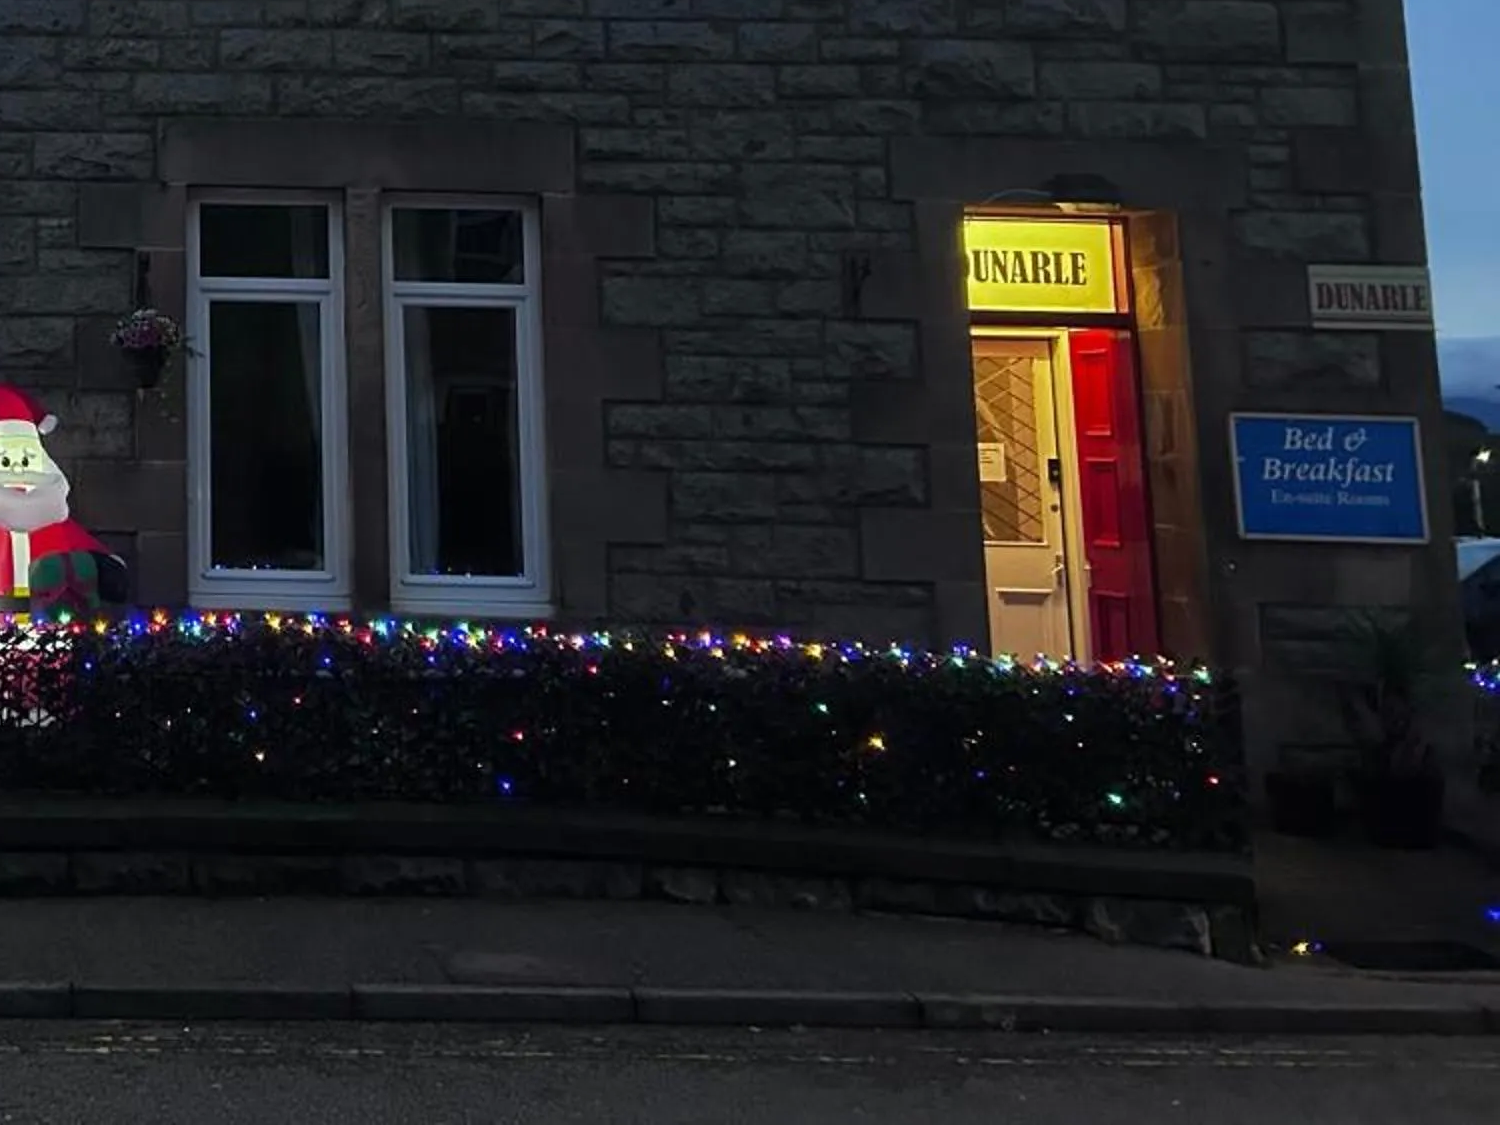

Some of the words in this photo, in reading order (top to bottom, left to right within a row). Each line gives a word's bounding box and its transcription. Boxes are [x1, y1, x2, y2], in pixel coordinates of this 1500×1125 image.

[966, 250, 1088, 285] UNARLE
[1315, 282, 1427, 311] DUNARLE
[1284, 427, 1334, 451] Bed
[1344, 428, 1368, 451] &
[1263, 457, 1395, 488] Breakfast
